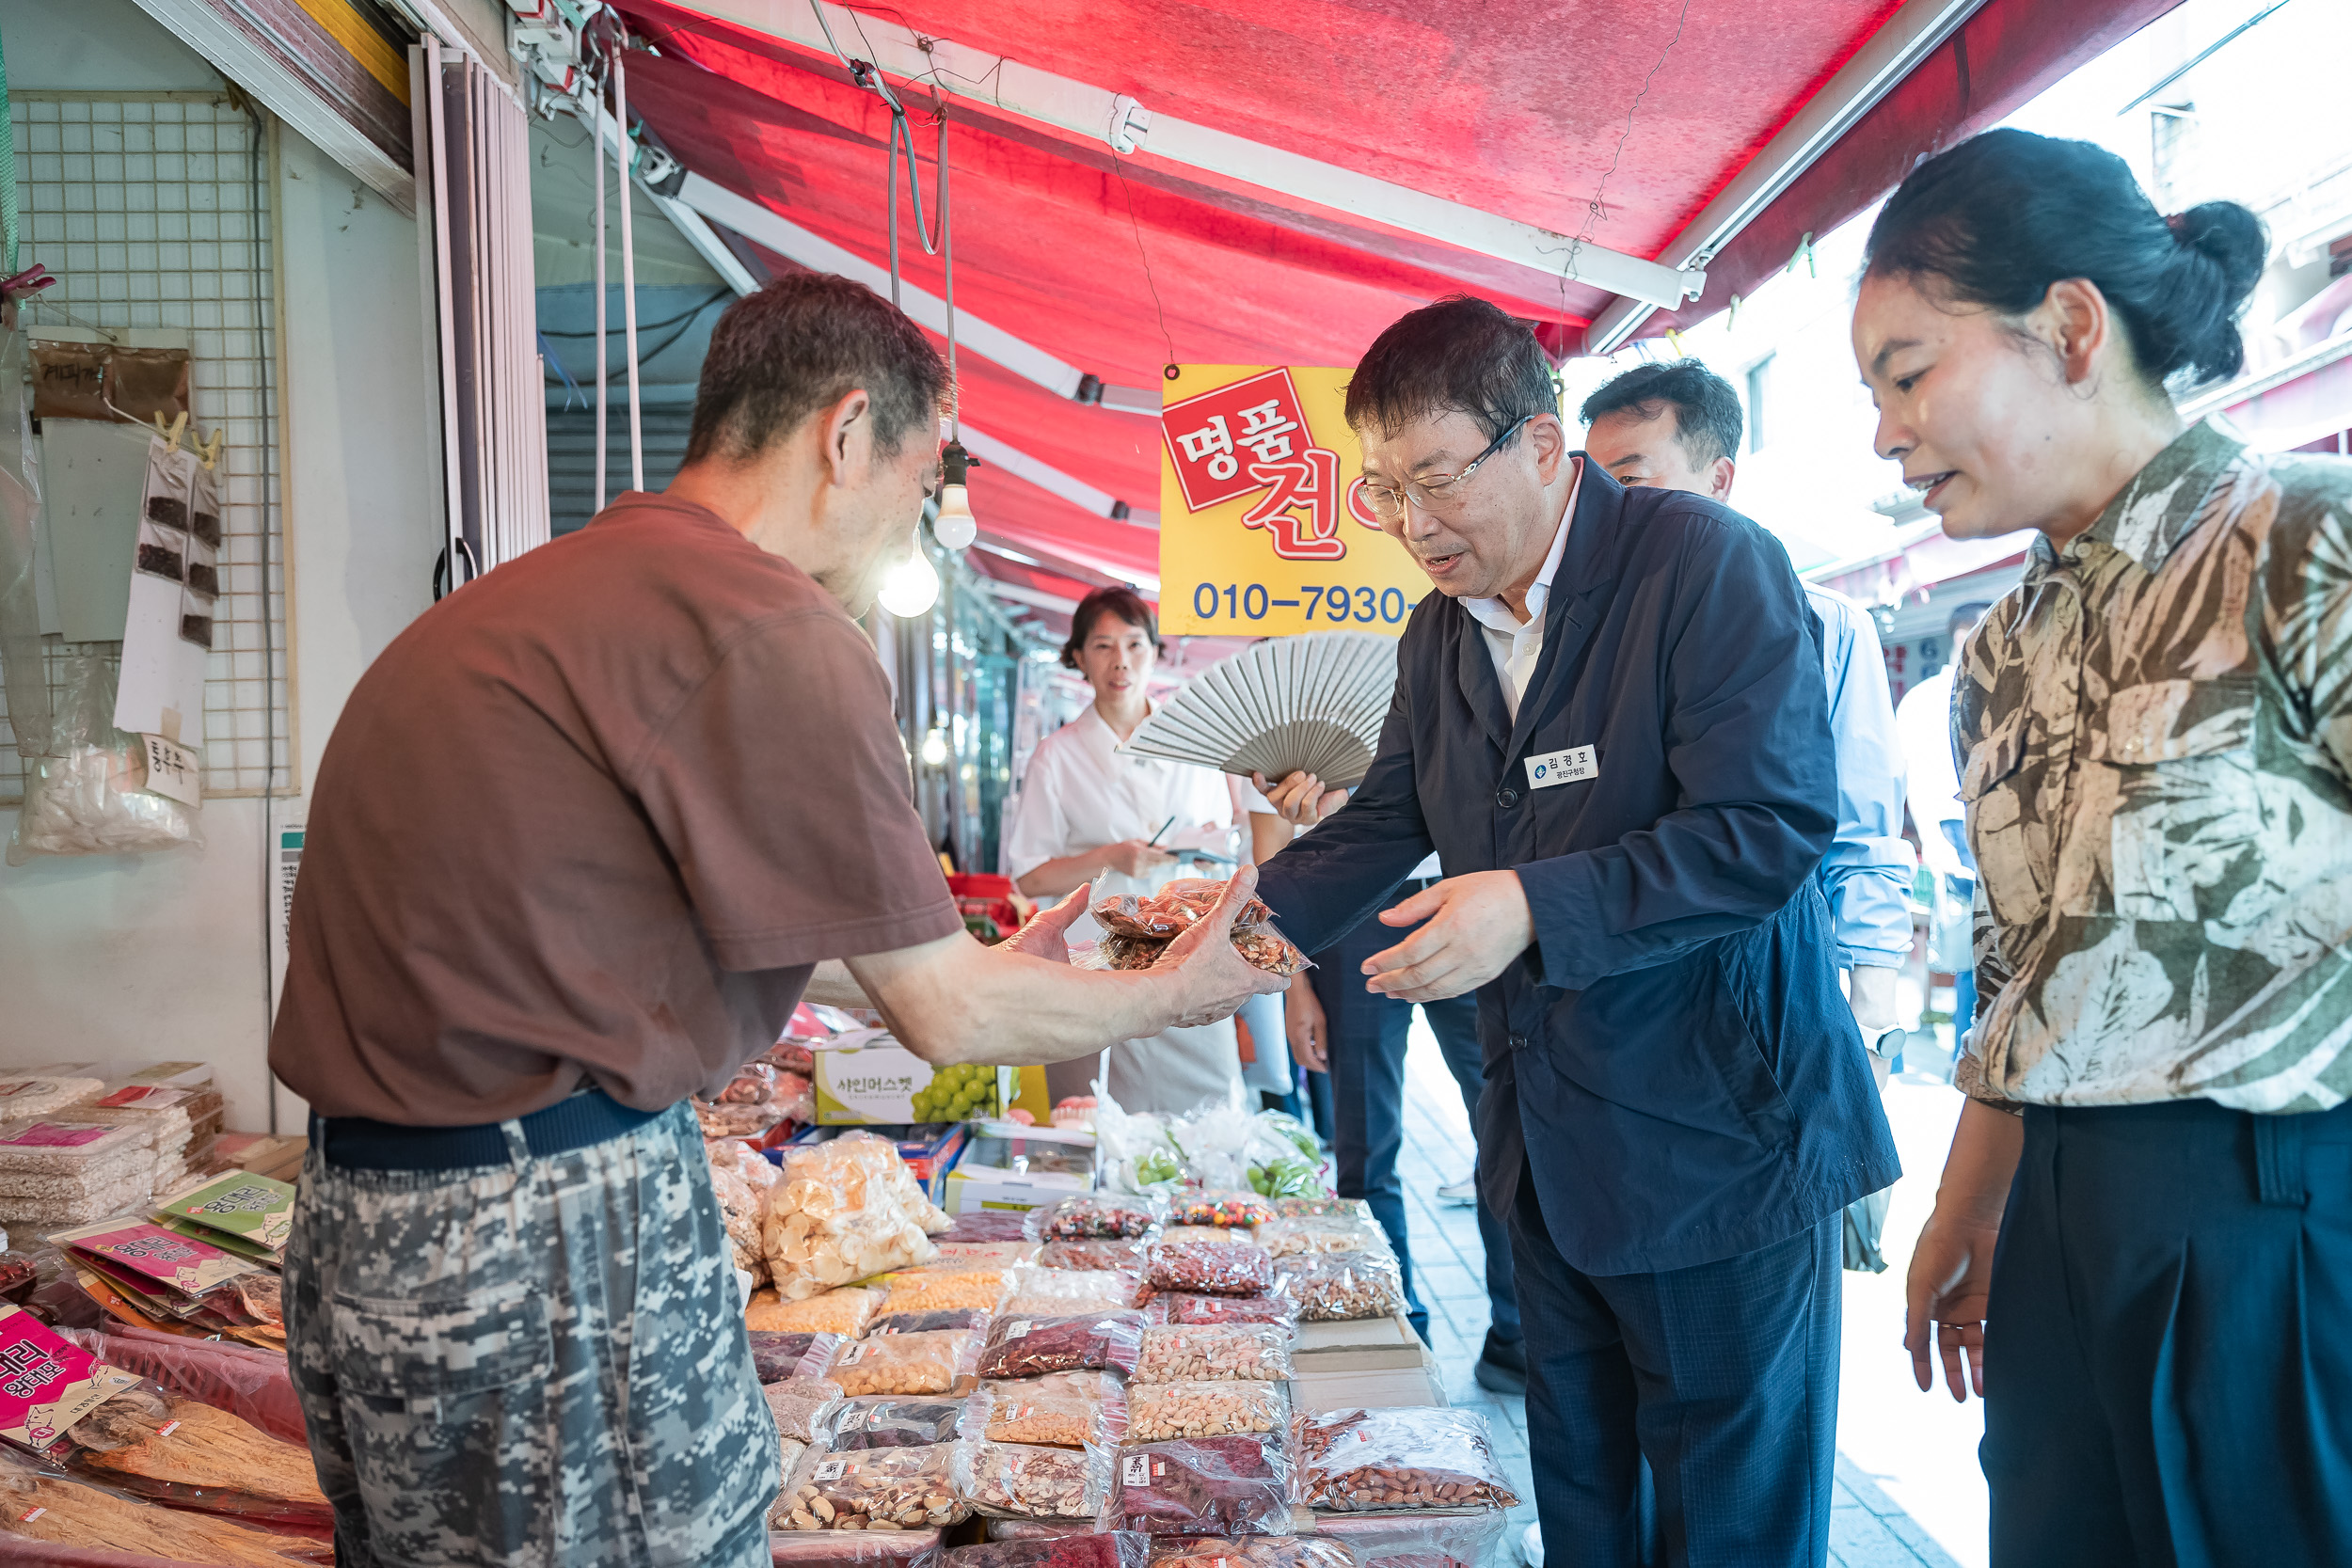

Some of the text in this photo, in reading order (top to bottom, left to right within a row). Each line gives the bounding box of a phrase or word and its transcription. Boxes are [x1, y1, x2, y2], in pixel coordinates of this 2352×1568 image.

[1176, 398, 1298, 482] 명품
[836, 1075, 913, 1093] 샤인머스켓
[2, 1361, 67, 1399] 왕태포
